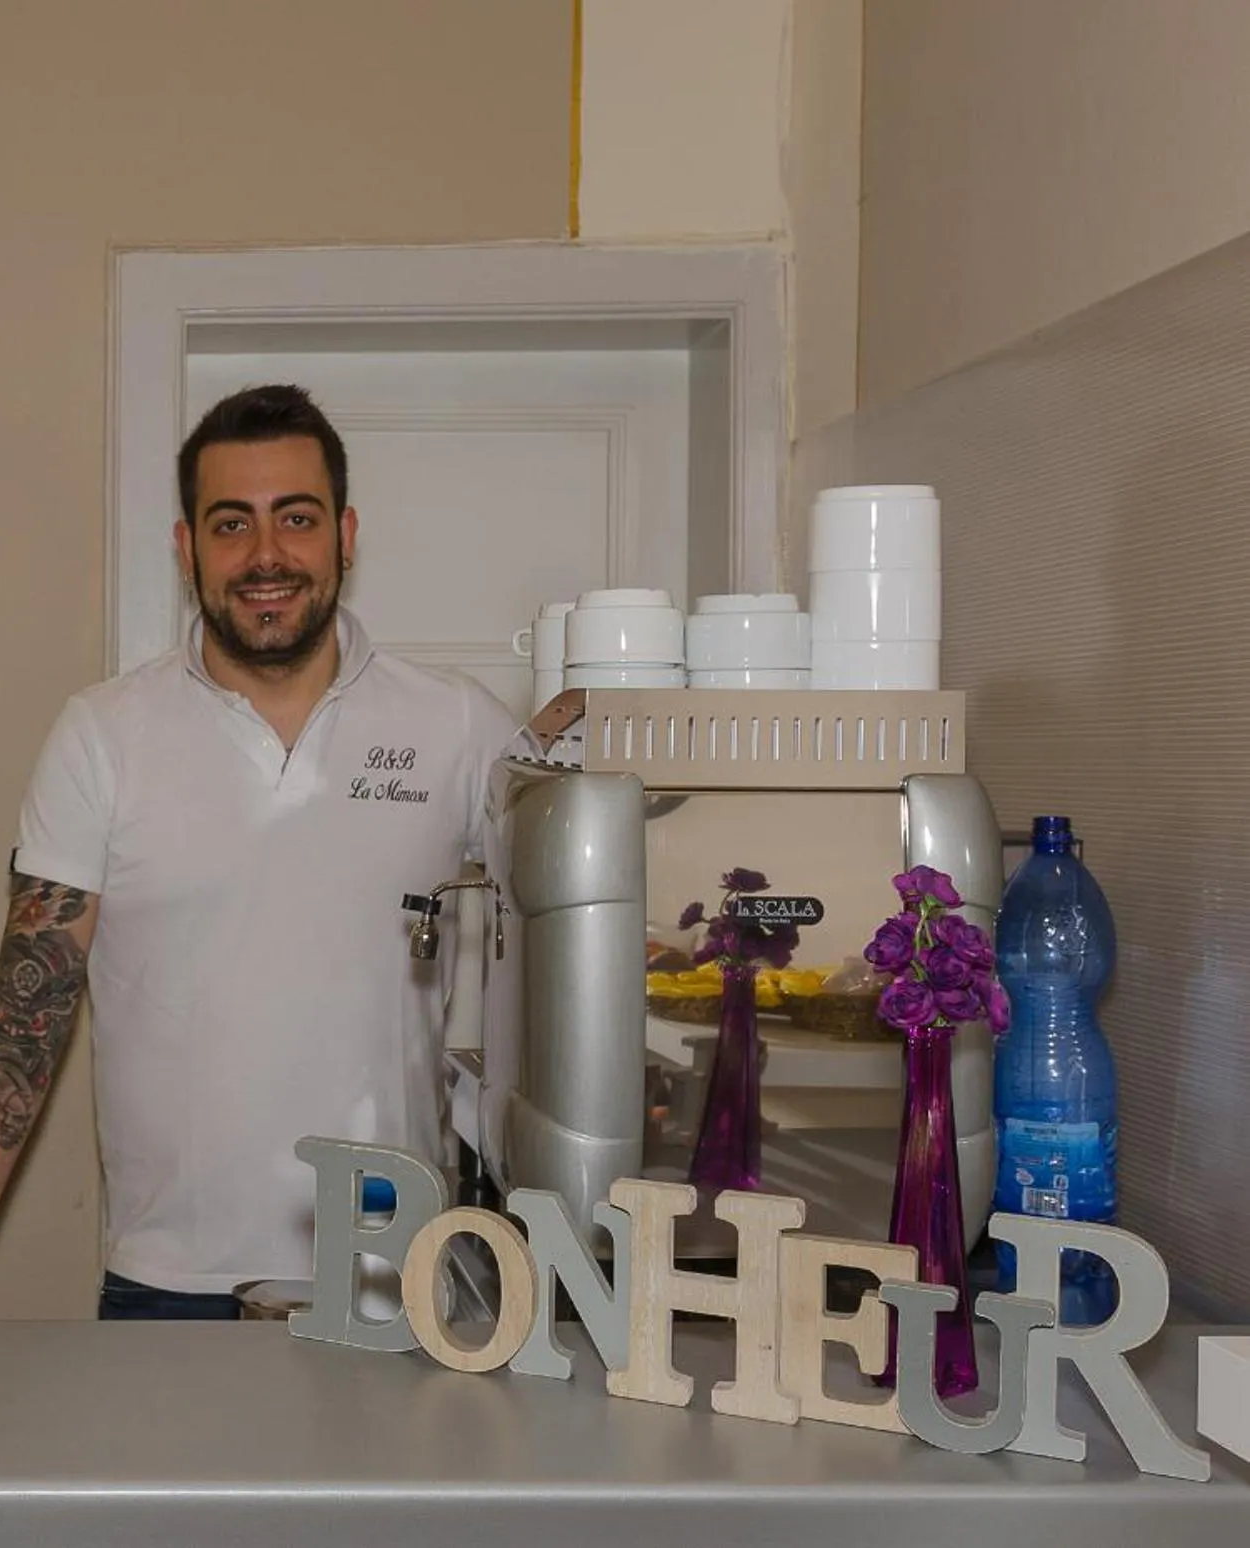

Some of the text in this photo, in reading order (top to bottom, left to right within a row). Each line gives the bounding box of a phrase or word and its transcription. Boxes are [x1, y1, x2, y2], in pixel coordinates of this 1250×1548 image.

[364, 746, 416, 770] B&B
[348, 777, 429, 802] La Mimosa
[754, 900, 817, 917] SCALA
[287, 1134, 1210, 1482] BONHEUR
